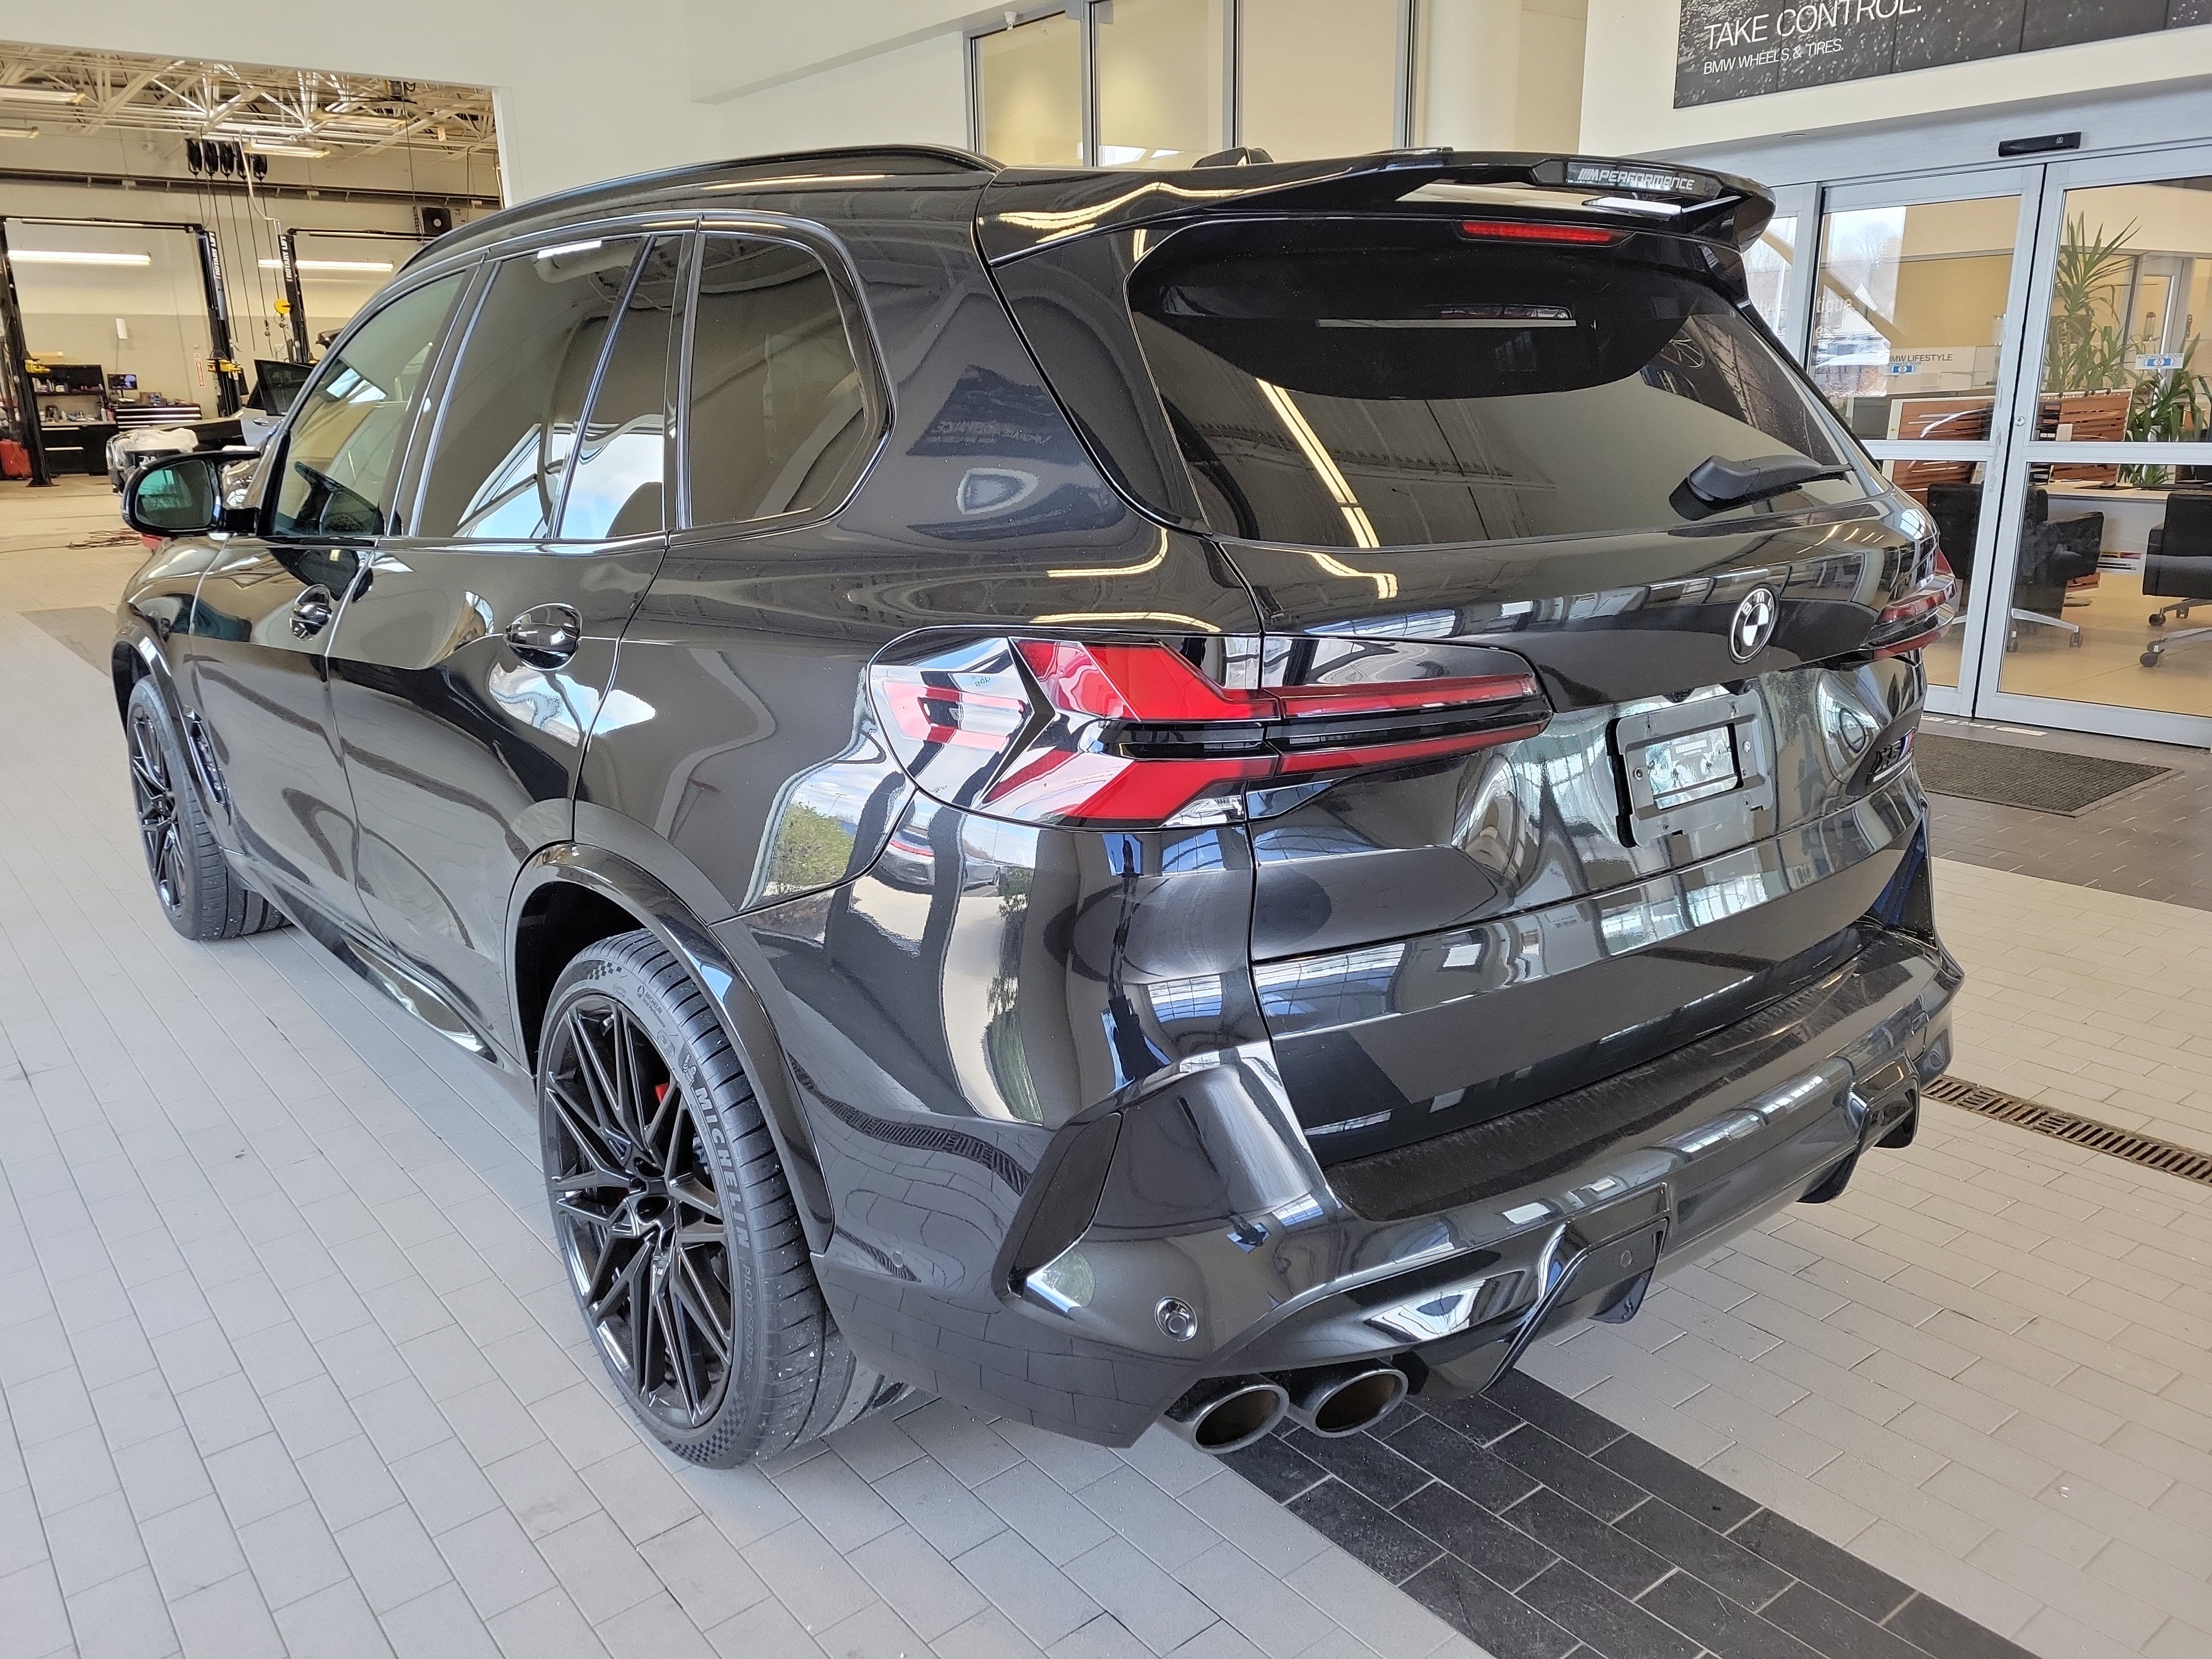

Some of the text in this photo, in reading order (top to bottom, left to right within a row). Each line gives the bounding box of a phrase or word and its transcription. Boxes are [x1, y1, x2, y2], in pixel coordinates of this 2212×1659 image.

[1704, 14, 1769, 50] TAKE
[1704, 38, 1844, 75] BMW WHEELS & TIRES.
[282, 251, 292, 278] ROTARY
[645, 992, 663, 1014] MICHELIN
[648, 1005, 665, 1028] Performance
[695, 1087, 751, 1250] MICHELIN
[743, 1263, 754, 1311] PILOT
[746, 1314, 754, 1367] SPORT
